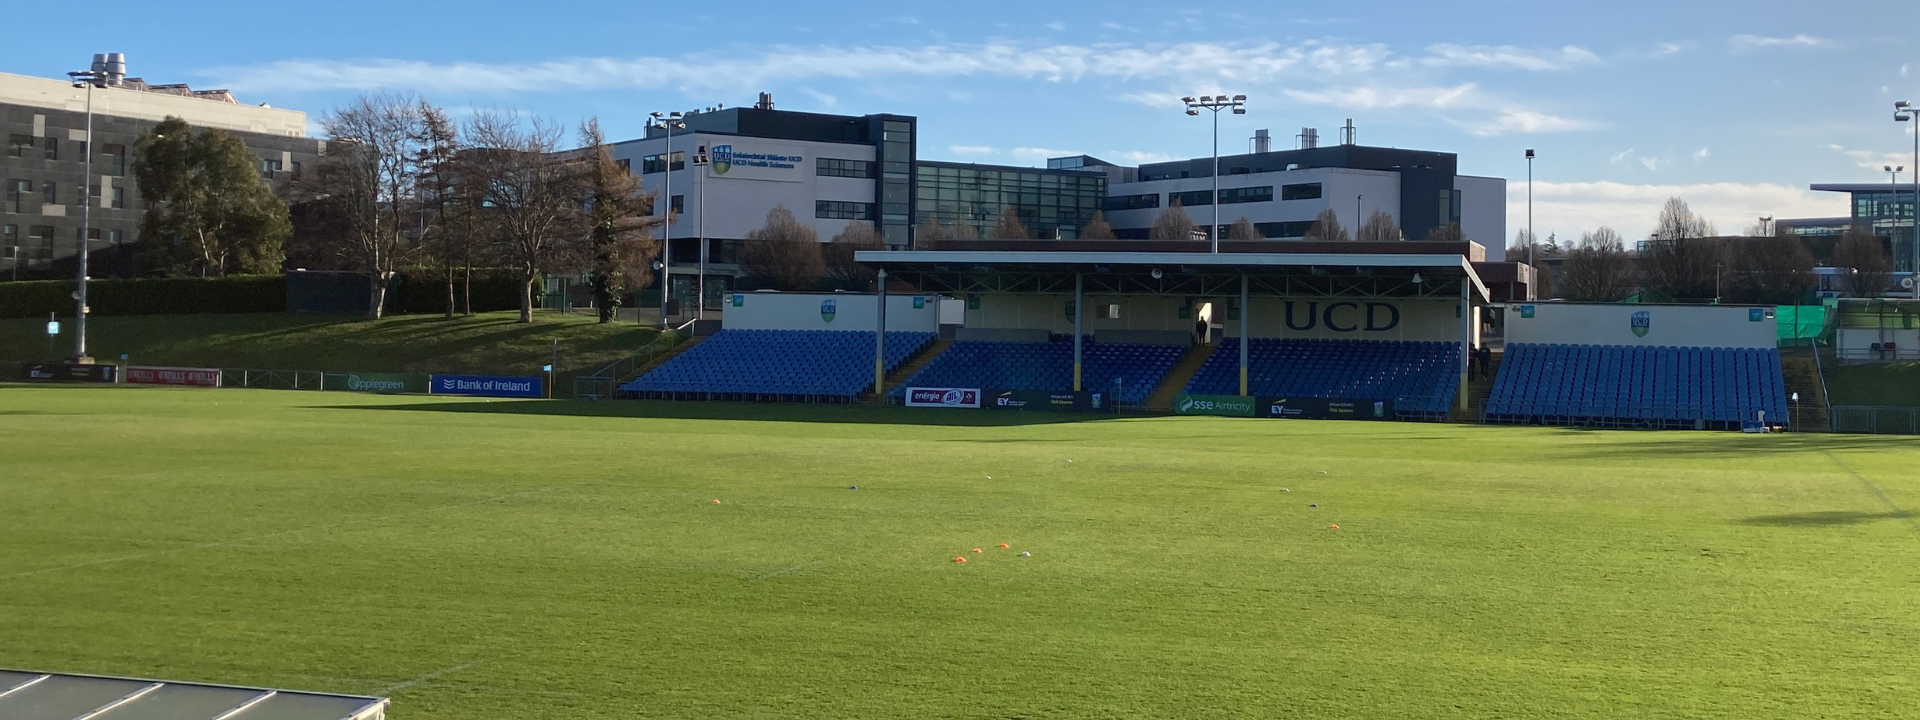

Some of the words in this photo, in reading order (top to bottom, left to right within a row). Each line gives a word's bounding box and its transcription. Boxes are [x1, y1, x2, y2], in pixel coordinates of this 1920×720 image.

[713, 152, 731, 160] UCD
[1283, 301, 1400, 332] UCD
[354, 379, 404, 390] applegreen
[457, 380, 481, 390] Bank
[483, 380, 493, 390] of
[495, 381, 530, 391] Ireland
[945, 391, 958, 402] AIL
[997, 398, 1010, 406] EY
[1194, 400, 1213, 410] sse
[1215, 401, 1250, 412] Airtricity
[1271, 405, 1284, 414] EY
